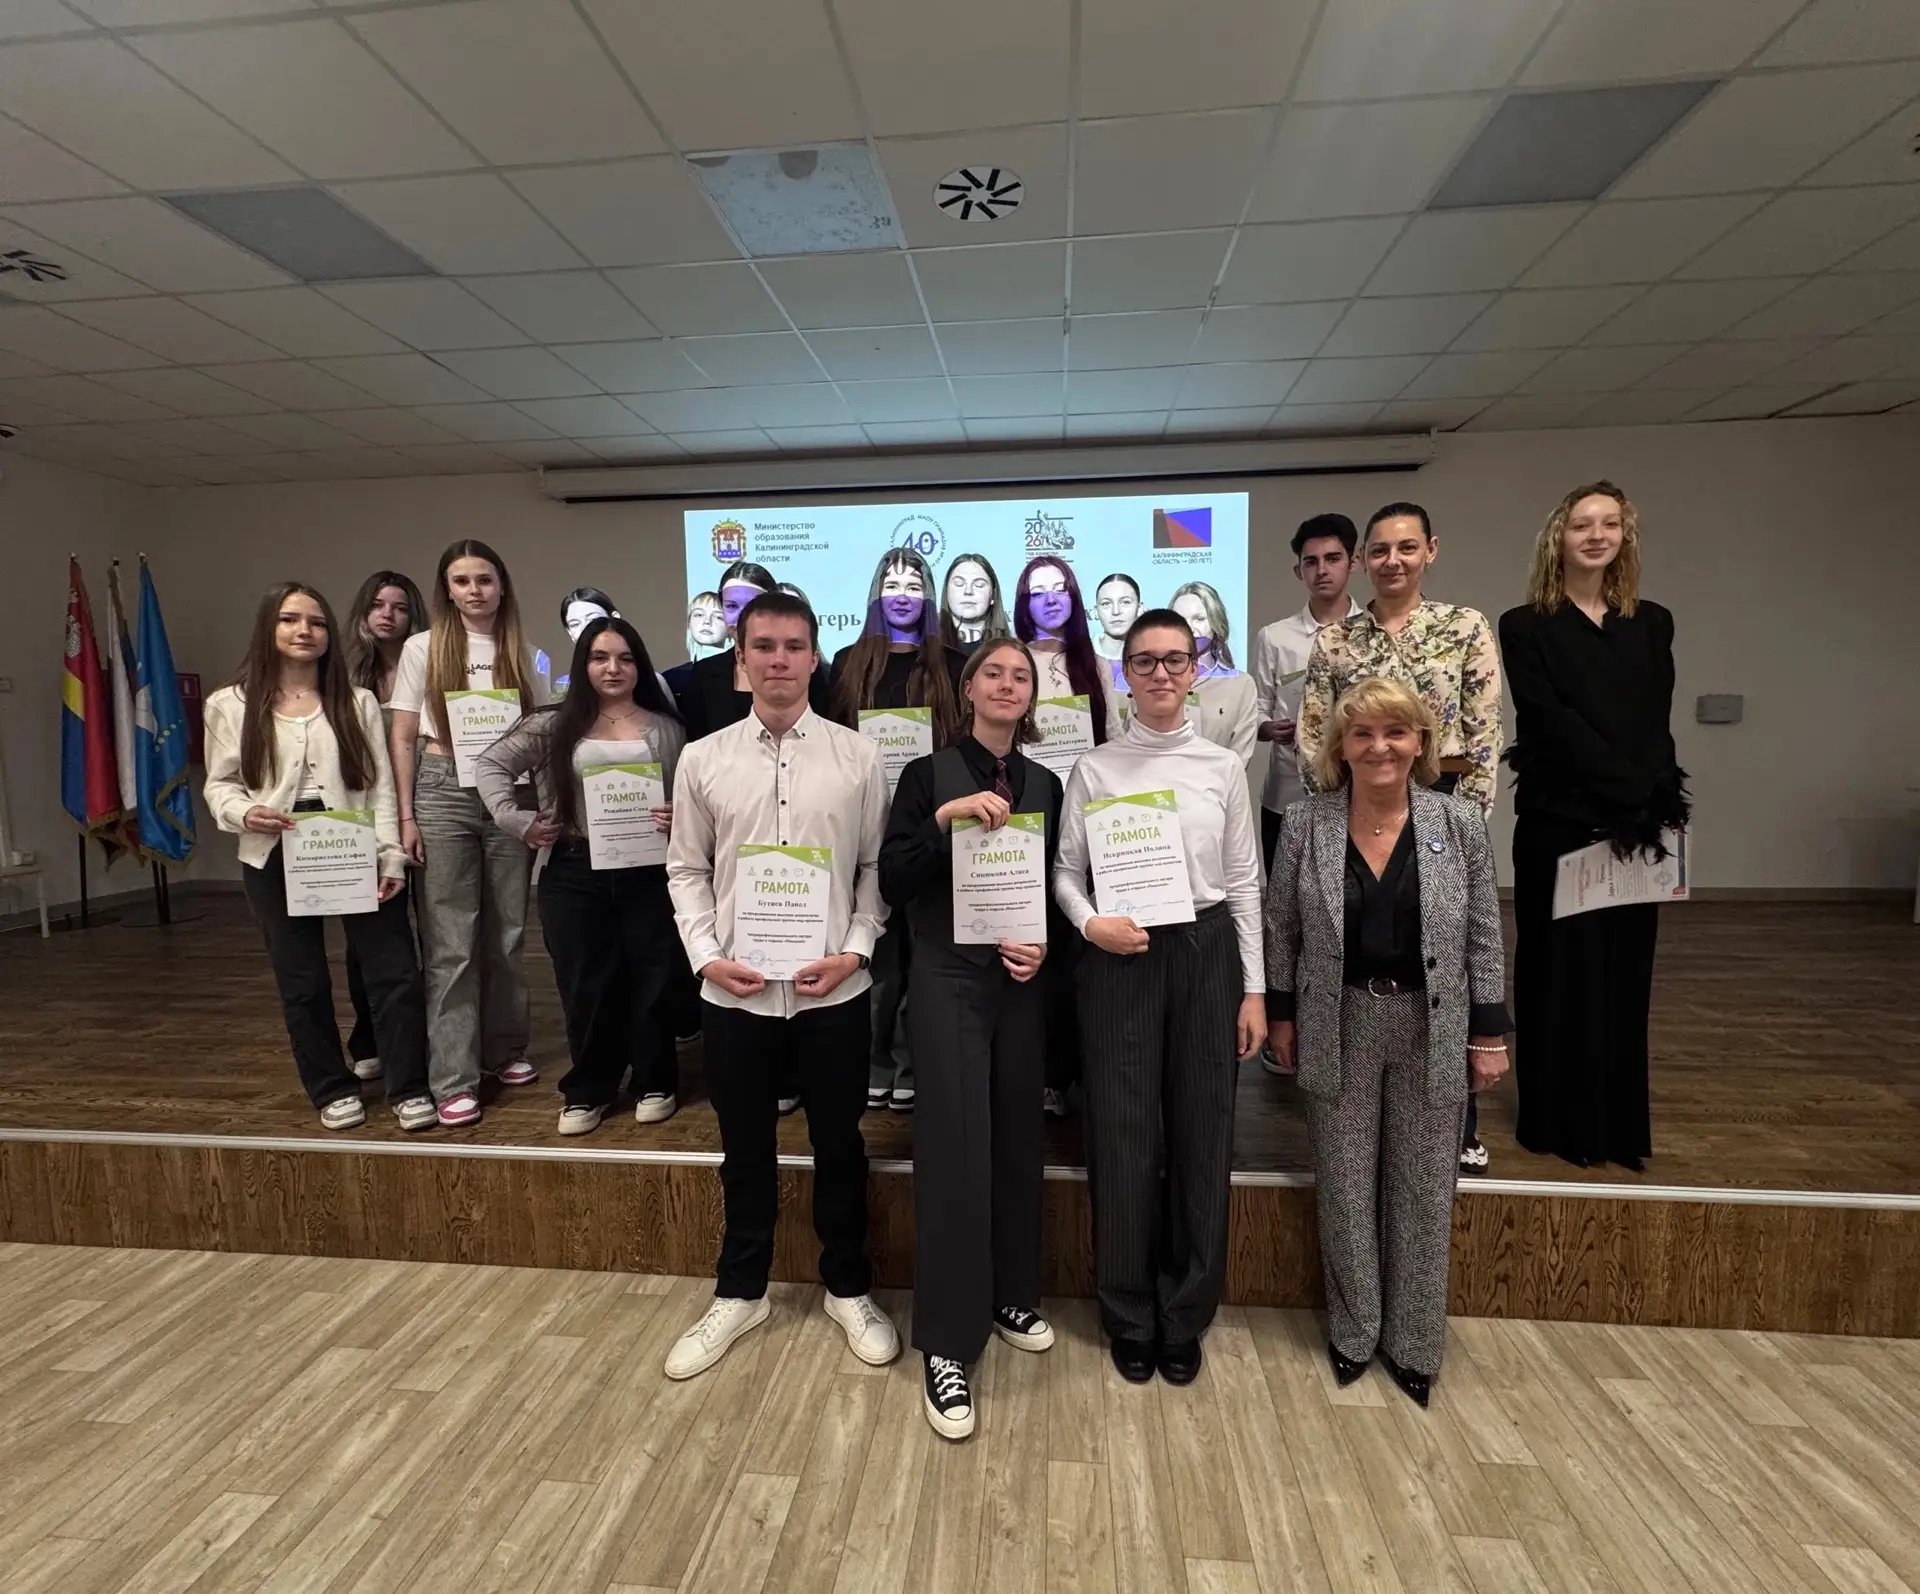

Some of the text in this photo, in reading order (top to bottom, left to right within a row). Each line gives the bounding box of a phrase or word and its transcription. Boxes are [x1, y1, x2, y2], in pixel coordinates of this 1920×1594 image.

[754, 523, 816, 531] Министерство
[1025, 521, 1041, 535] 20
[754, 532, 810, 542] образования
[1025, 534, 1041, 548] 26
[755, 541, 829, 552] Калининградской
[755, 555, 791, 563] области
[462, 715, 506, 727] ГРАМОТА
[1040, 724, 1078, 737] РАМОТА
[600, 792, 648, 804] ГРАМОТА
[1105, 826, 1161, 845] ГРАМОТА
[303, 838, 357, 850] ГРАМОТА
[972, 850, 1026, 865] ГРАМОТА
[755, 880, 810, 894] ГРАМОТА
